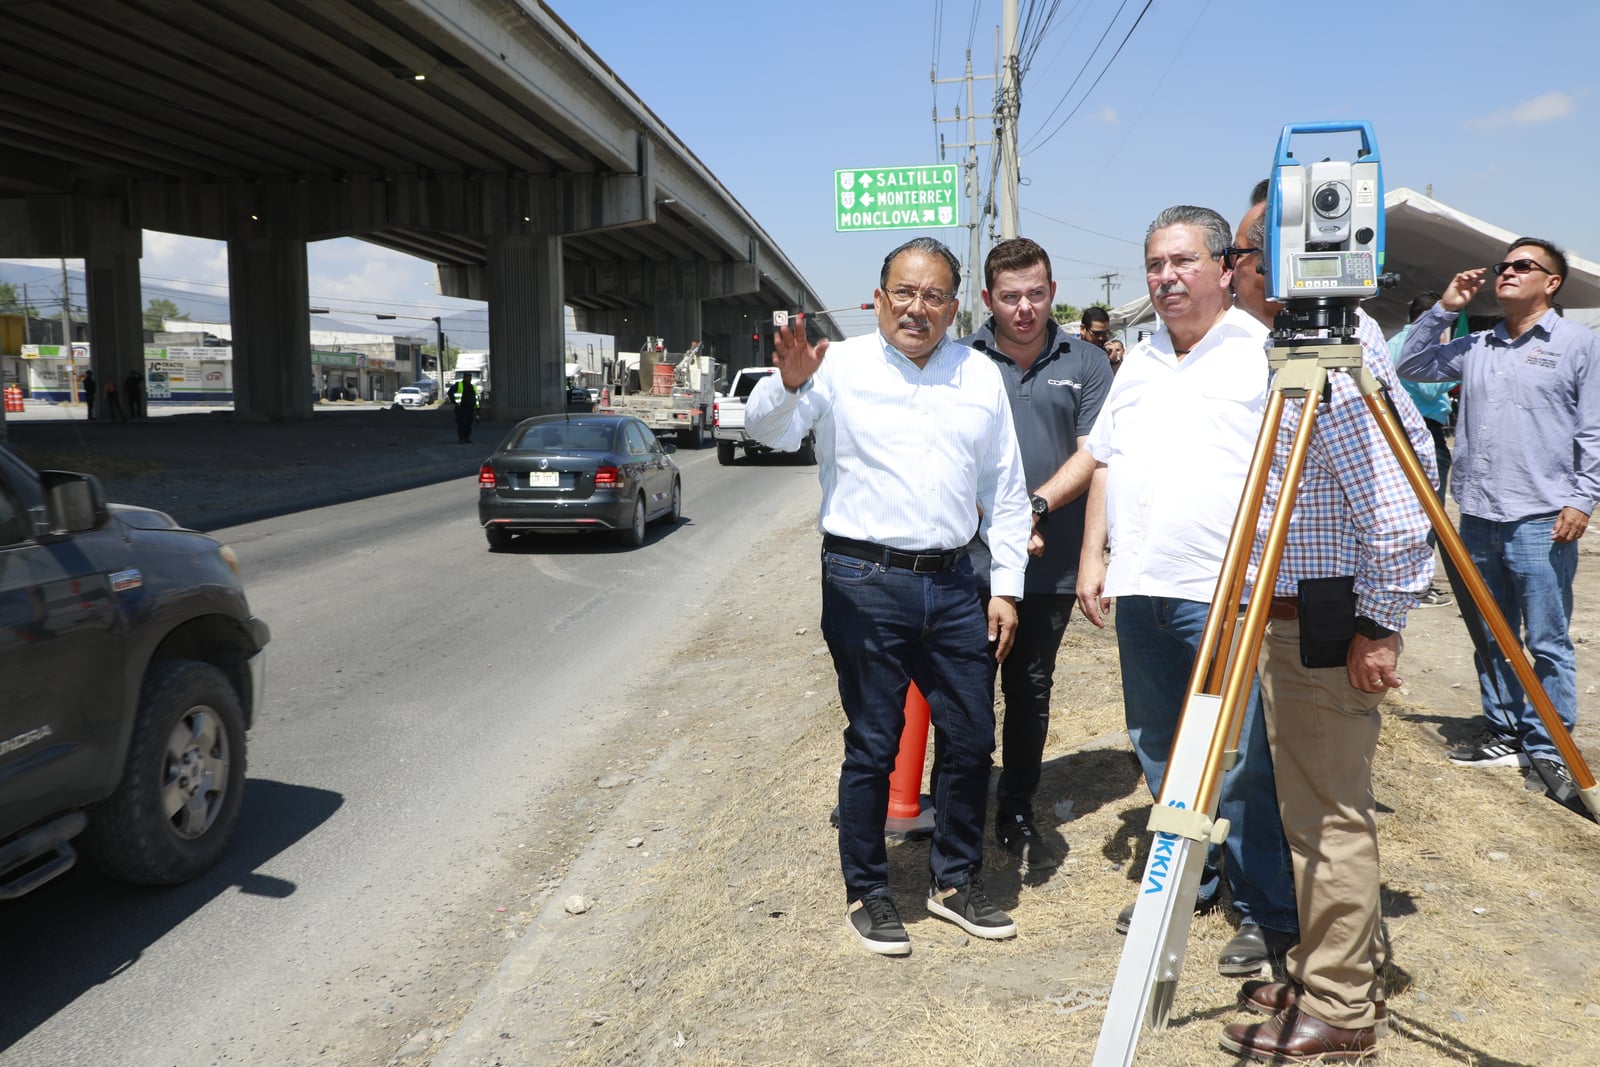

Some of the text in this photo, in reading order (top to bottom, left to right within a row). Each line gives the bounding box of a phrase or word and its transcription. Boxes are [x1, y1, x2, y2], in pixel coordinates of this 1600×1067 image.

[876, 170, 952, 187] SALTILLO
[877, 189, 952, 206] MONTERREY
[841, 210, 920, 227] MONCLOVA
